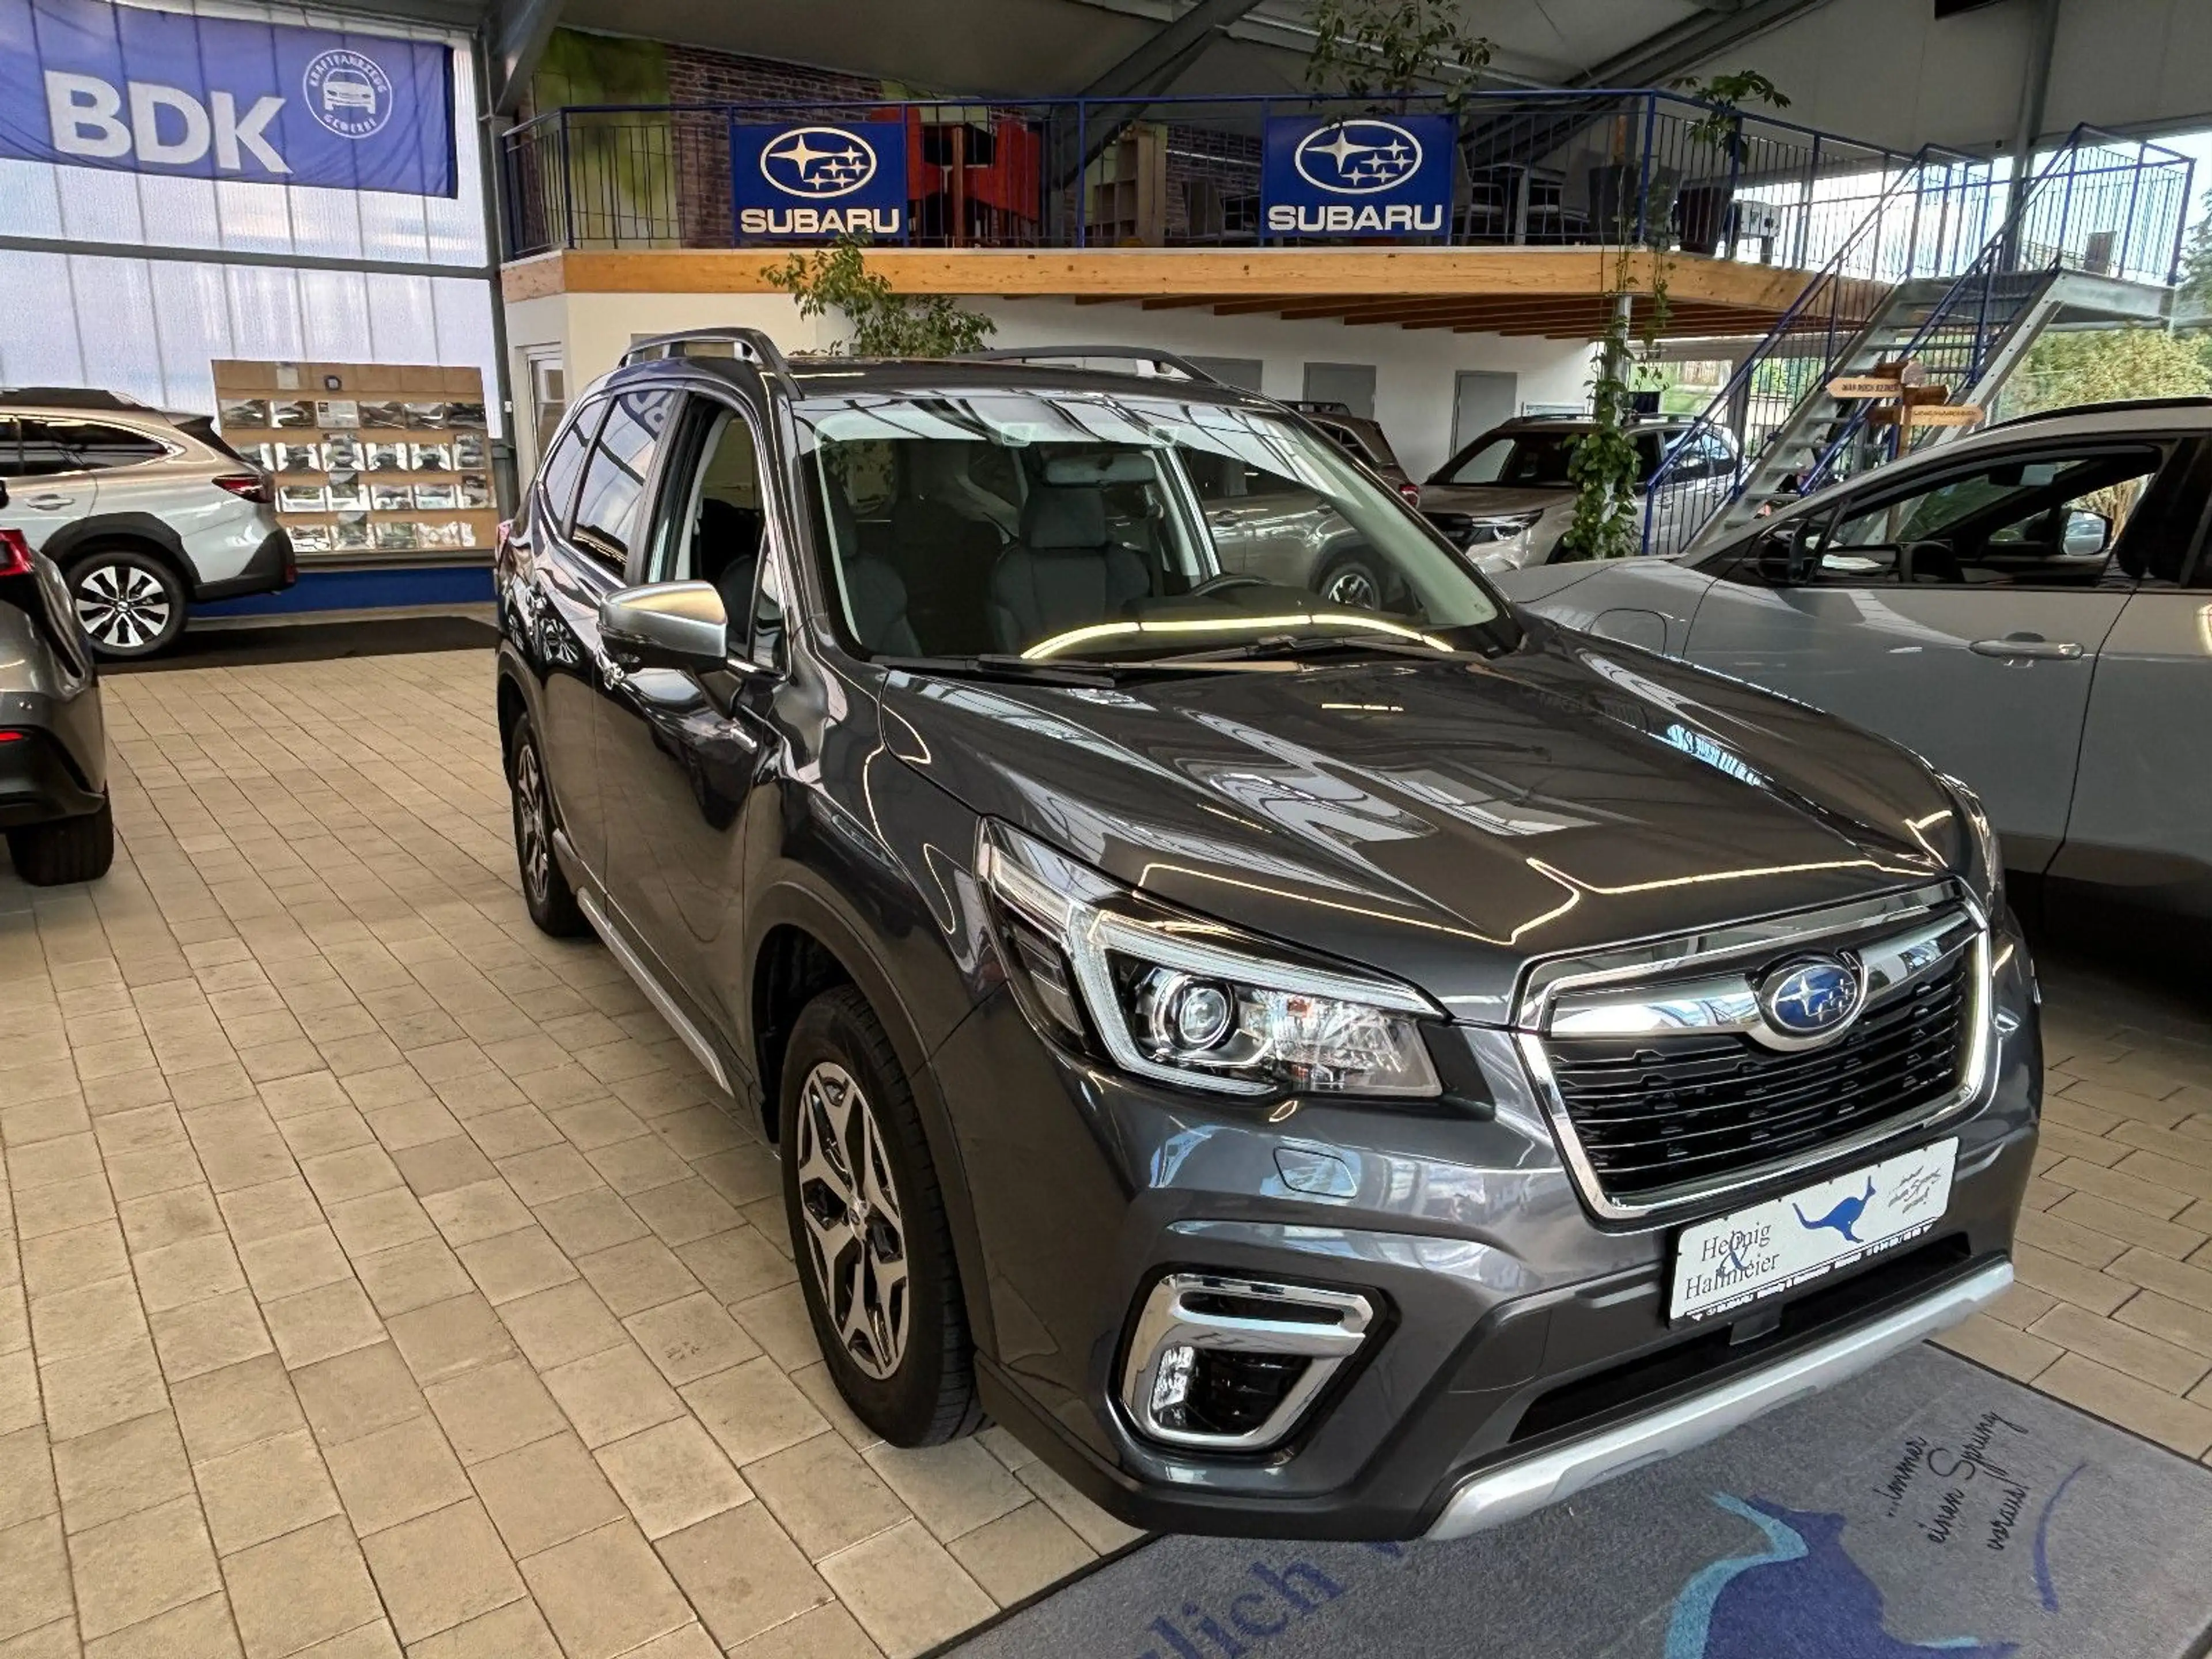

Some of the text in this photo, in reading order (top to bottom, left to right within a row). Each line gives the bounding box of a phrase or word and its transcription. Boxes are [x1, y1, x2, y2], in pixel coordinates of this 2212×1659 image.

[44, 70, 294, 173] BDK
[740, 208, 900, 234] SUBARU
[1268, 204, 1443, 232] SUBARU
[1927, 1411, 2029, 1480] Sprung
[1132, 1560, 1346, 1659] lich
